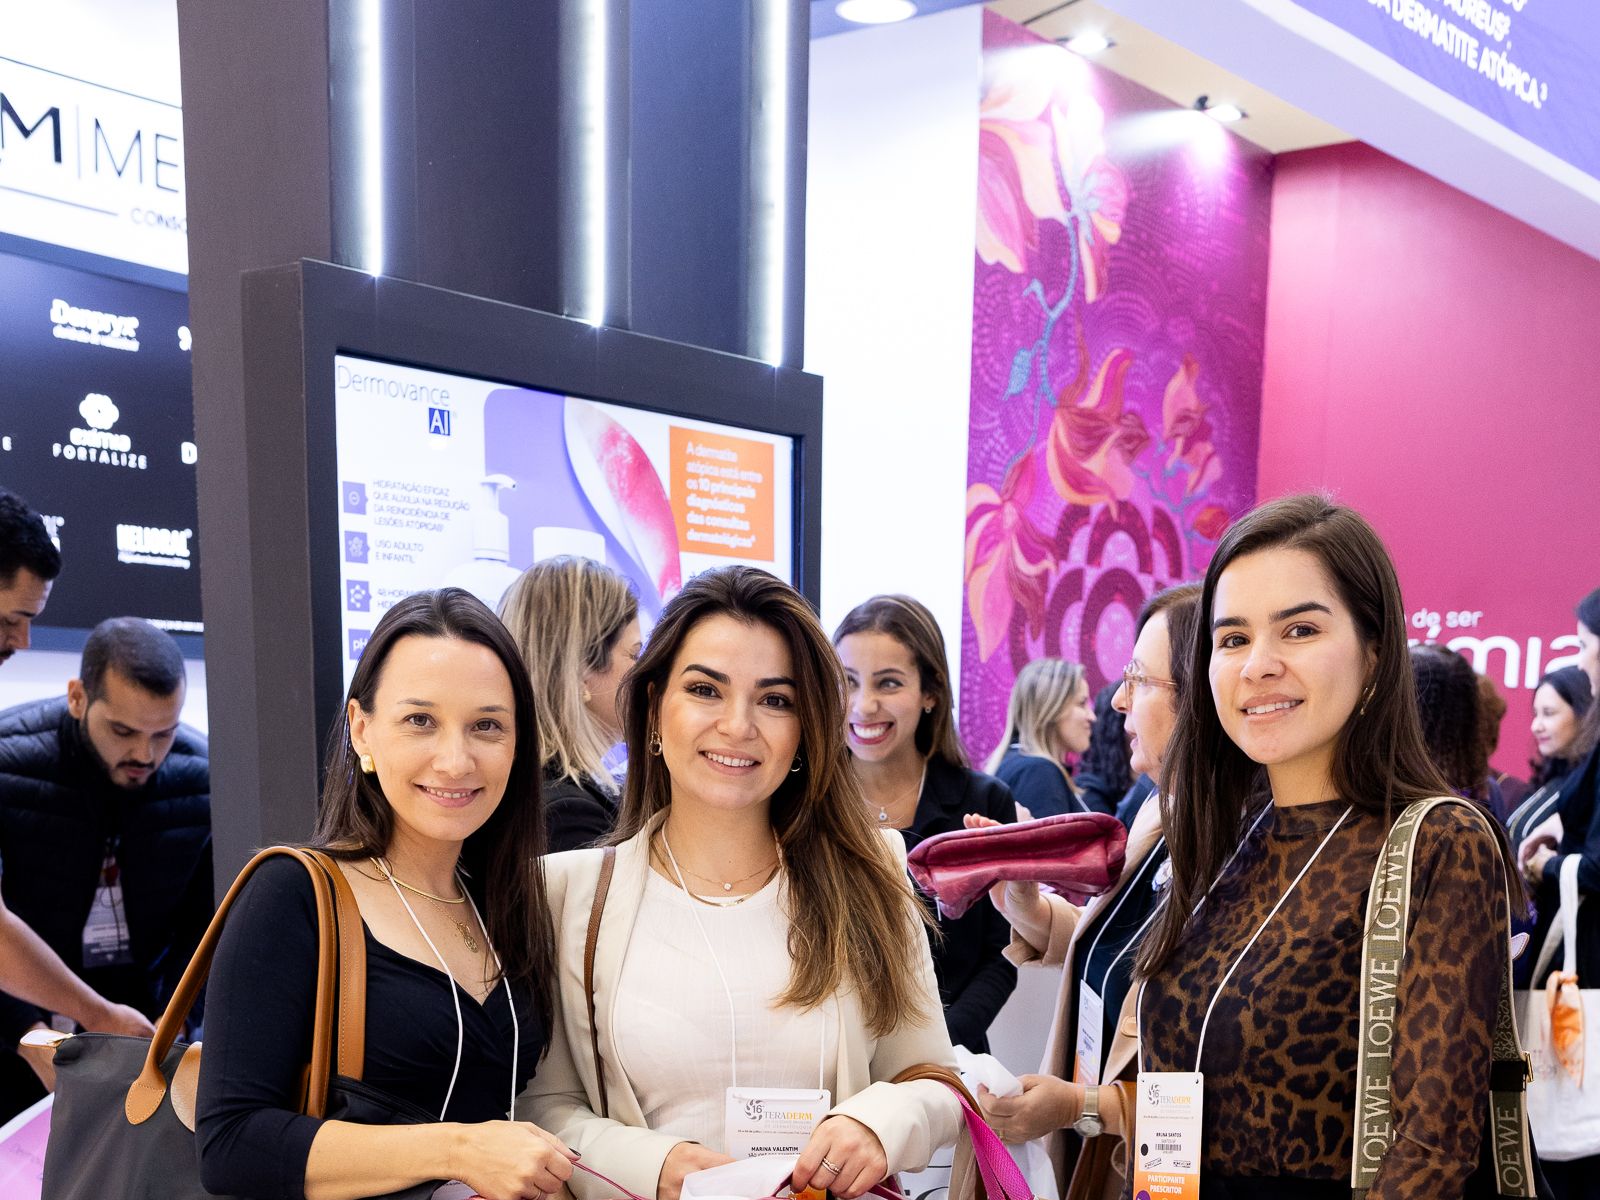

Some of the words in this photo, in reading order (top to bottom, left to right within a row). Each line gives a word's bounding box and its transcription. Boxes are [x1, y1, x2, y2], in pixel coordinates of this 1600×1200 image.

[338, 365, 450, 407] Dermovance
[429, 408, 450, 435] AI
[1446, 610, 1483, 628] ser
[1373, 841, 1408, 942] LOEWE
[1367, 959, 1399, 1060] LOEWE
[764, 1111, 813, 1120] TERADERM
